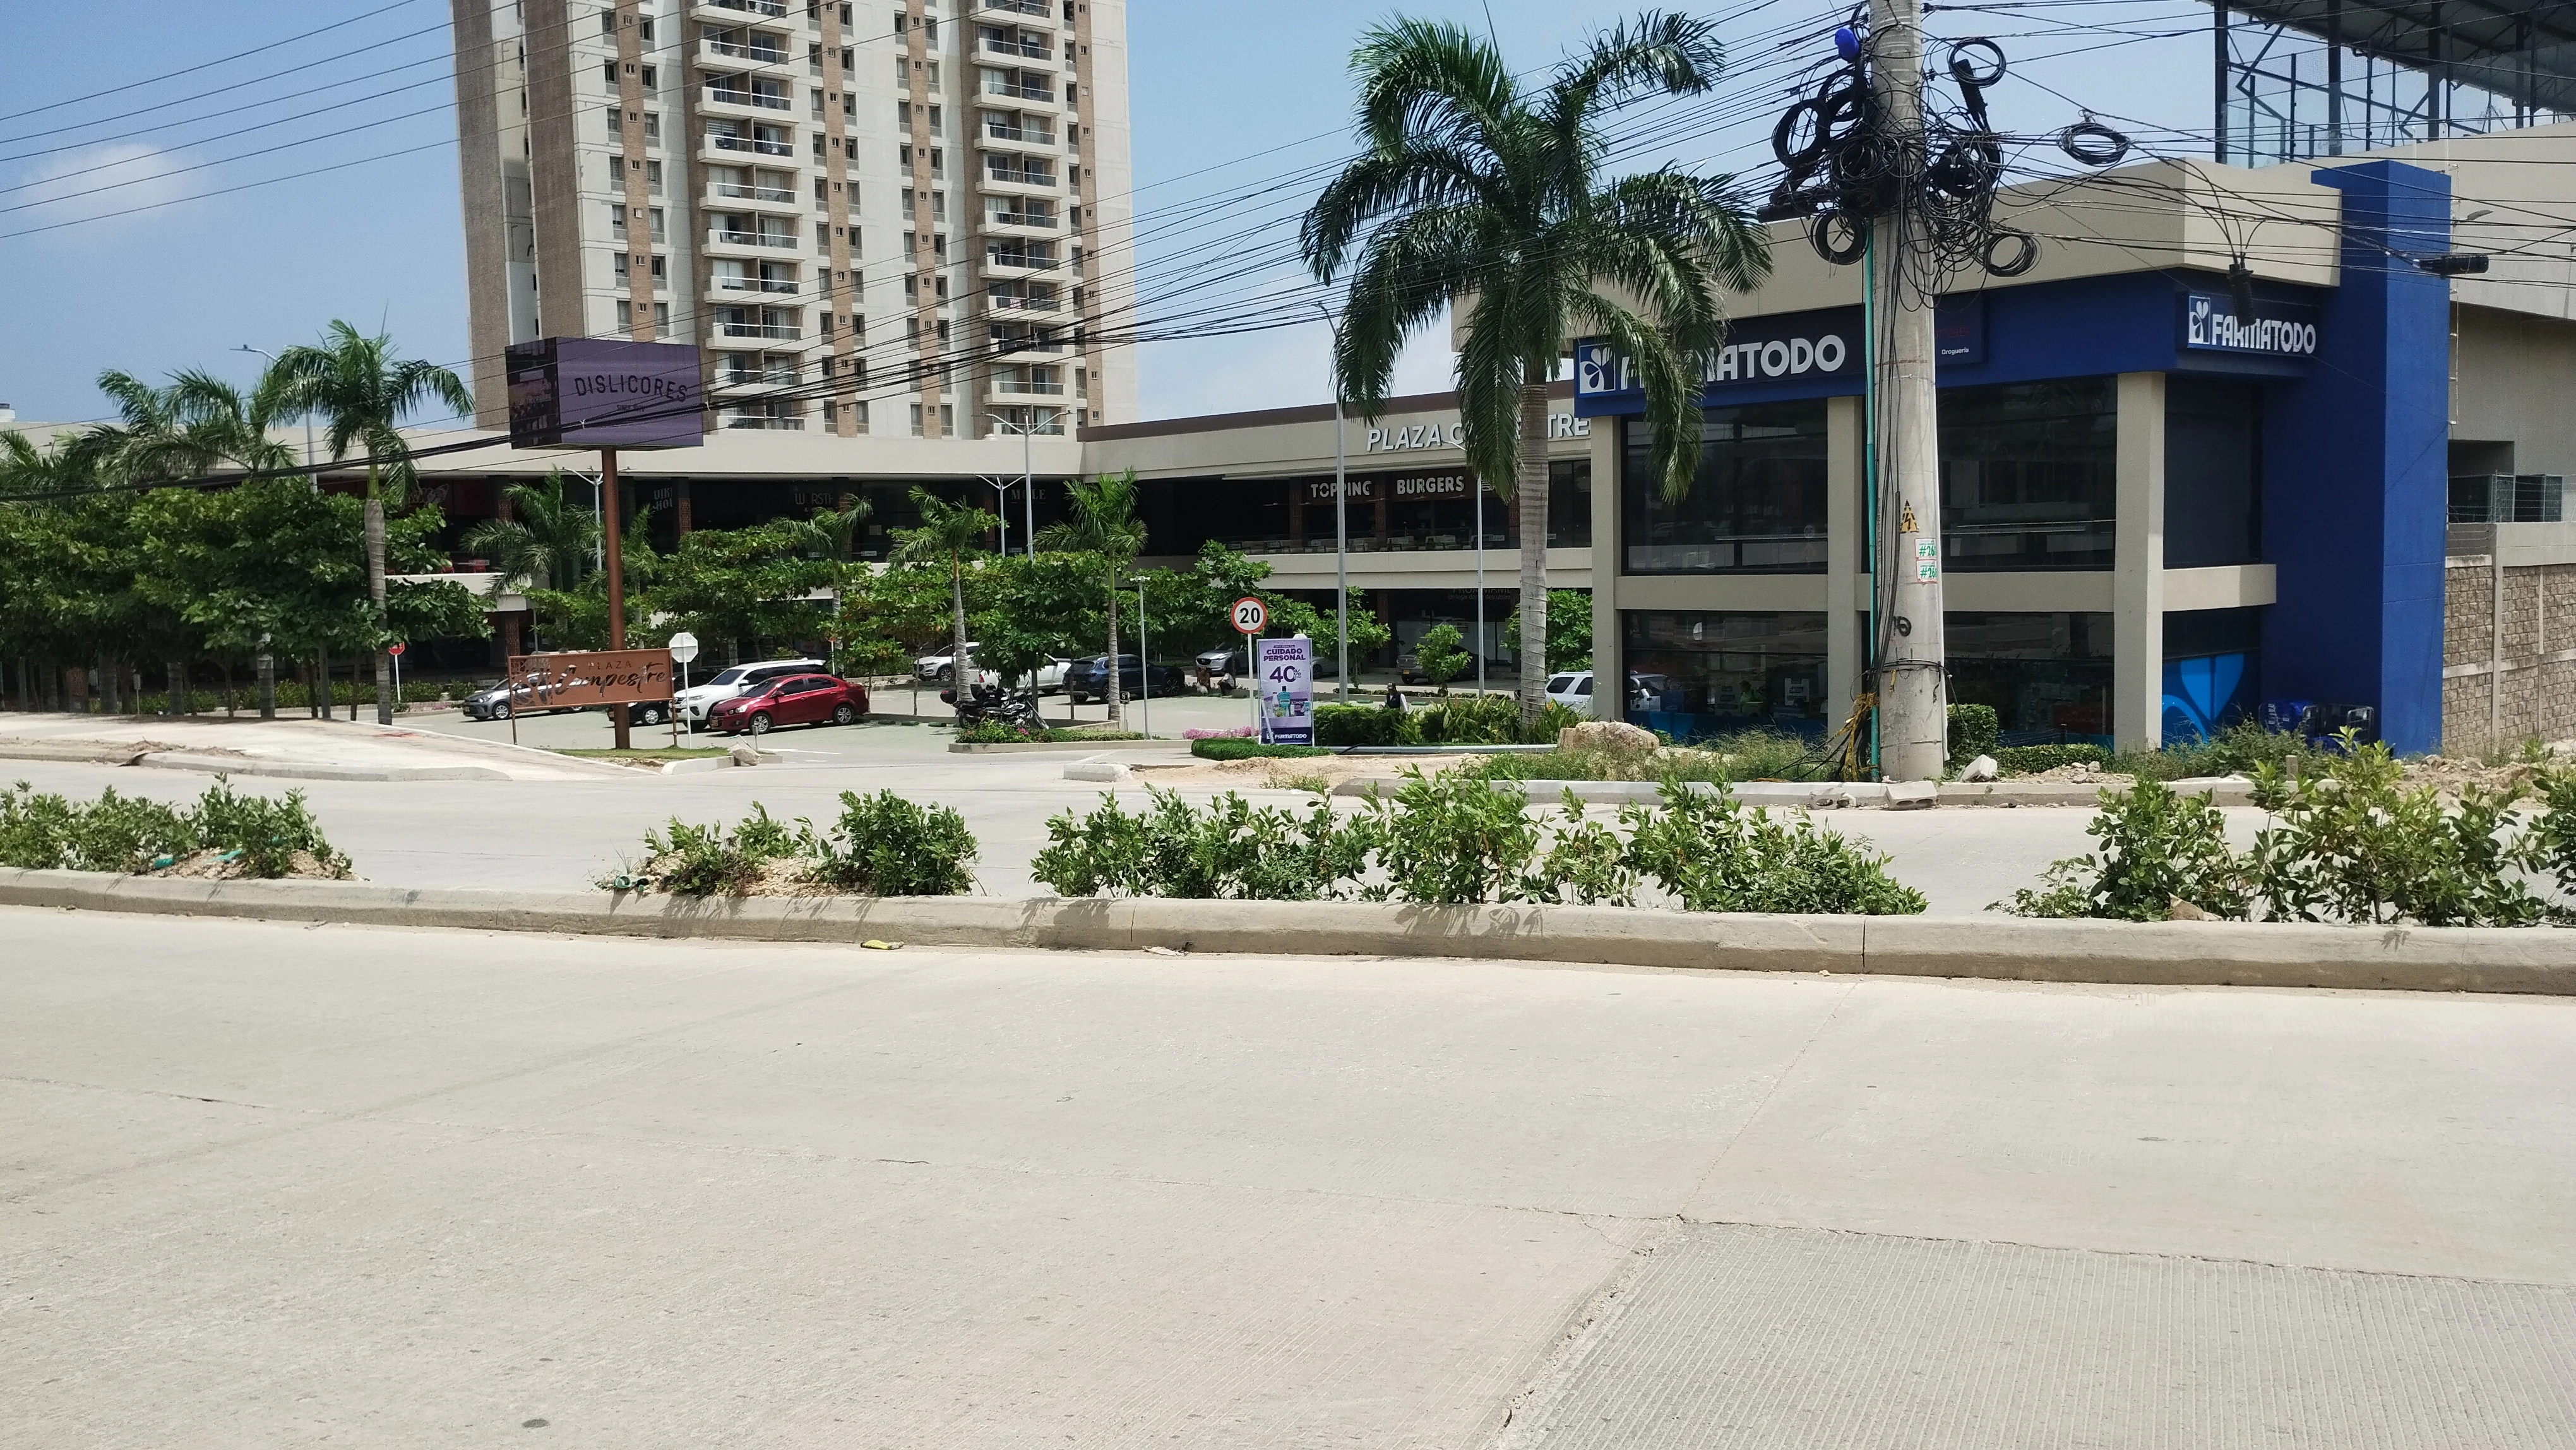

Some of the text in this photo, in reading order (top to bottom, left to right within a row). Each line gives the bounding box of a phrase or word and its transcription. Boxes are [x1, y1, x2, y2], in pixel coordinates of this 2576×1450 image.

[574, 374, 688, 402] DISLICORES
[1366, 424, 1443, 452] PLAZA
[1396, 476, 1465, 494] BURGERS
[1011, 489, 1046, 500] MLE
[1239, 607, 1260, 623] 20
[588, 661, 632, 670] PLAZA
